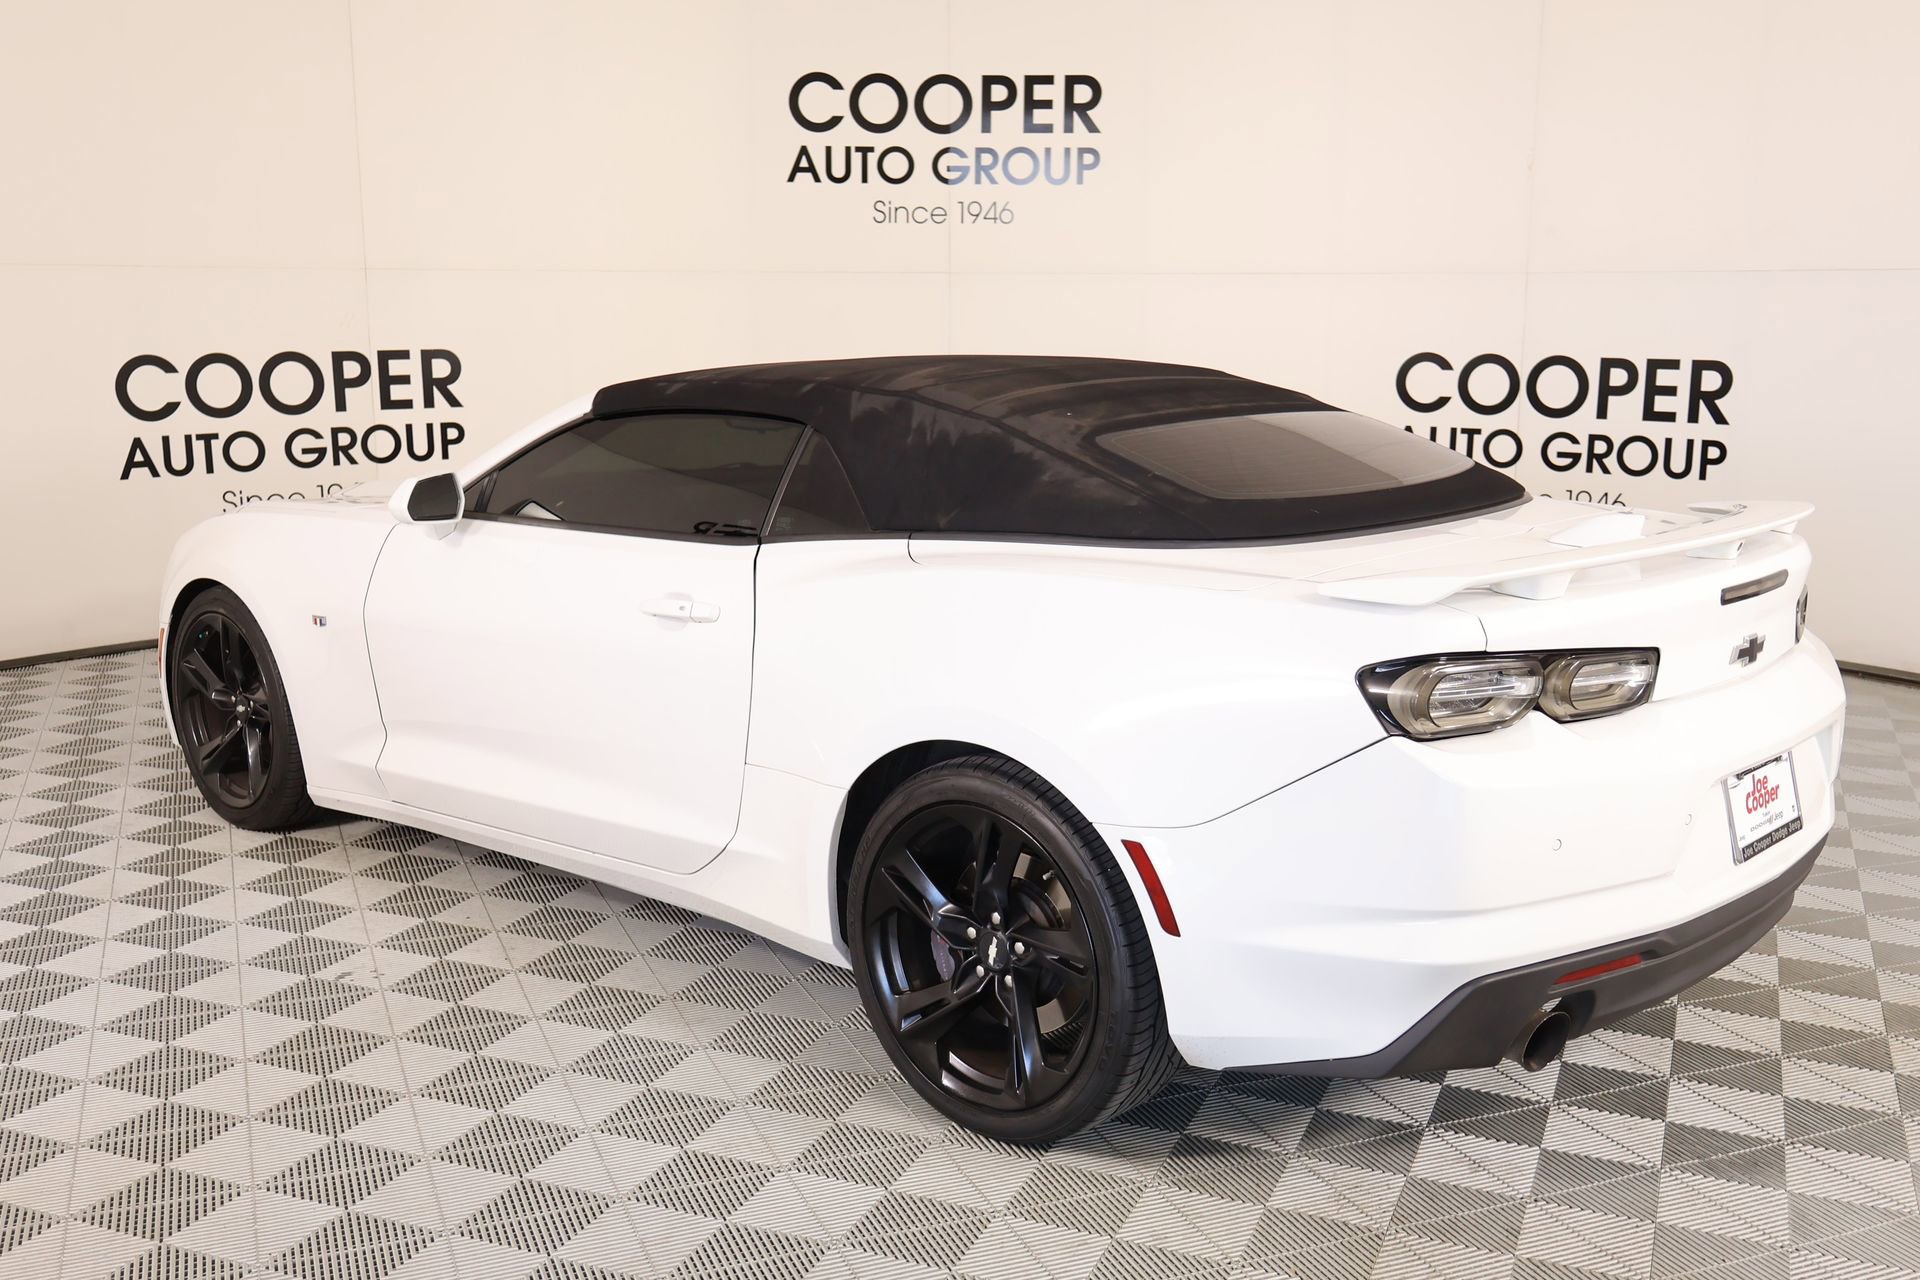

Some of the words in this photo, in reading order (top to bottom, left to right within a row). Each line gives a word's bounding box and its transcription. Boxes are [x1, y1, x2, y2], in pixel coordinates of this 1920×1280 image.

[788, 71, 1103, 135] COOPER
[786, 144, 915, 185] AUTO
[931, 146, 1101, 186] GROUP
[872, 199, 948, 225] Since
[956, 200, 1015, 225] 1946
[114, 348, 465, 423] COOPER
[1395, 351, 1734, 426] COOPER
[119, 430, 267, 481] AUTO
[283, 421, 466, 470] GROUP
[1403, 425, 1524, 469] TO
[1540, 431, 1728, 481] GROUP
[1745, 784, 1780, 814] Cooper
[1751, 773, 1769, 796] Joe
[1753, 834, 1772, 852] Cooper
[1771, 826, 1788, 844] Dodge
[1788, 819, 1801, 832] Jeep
